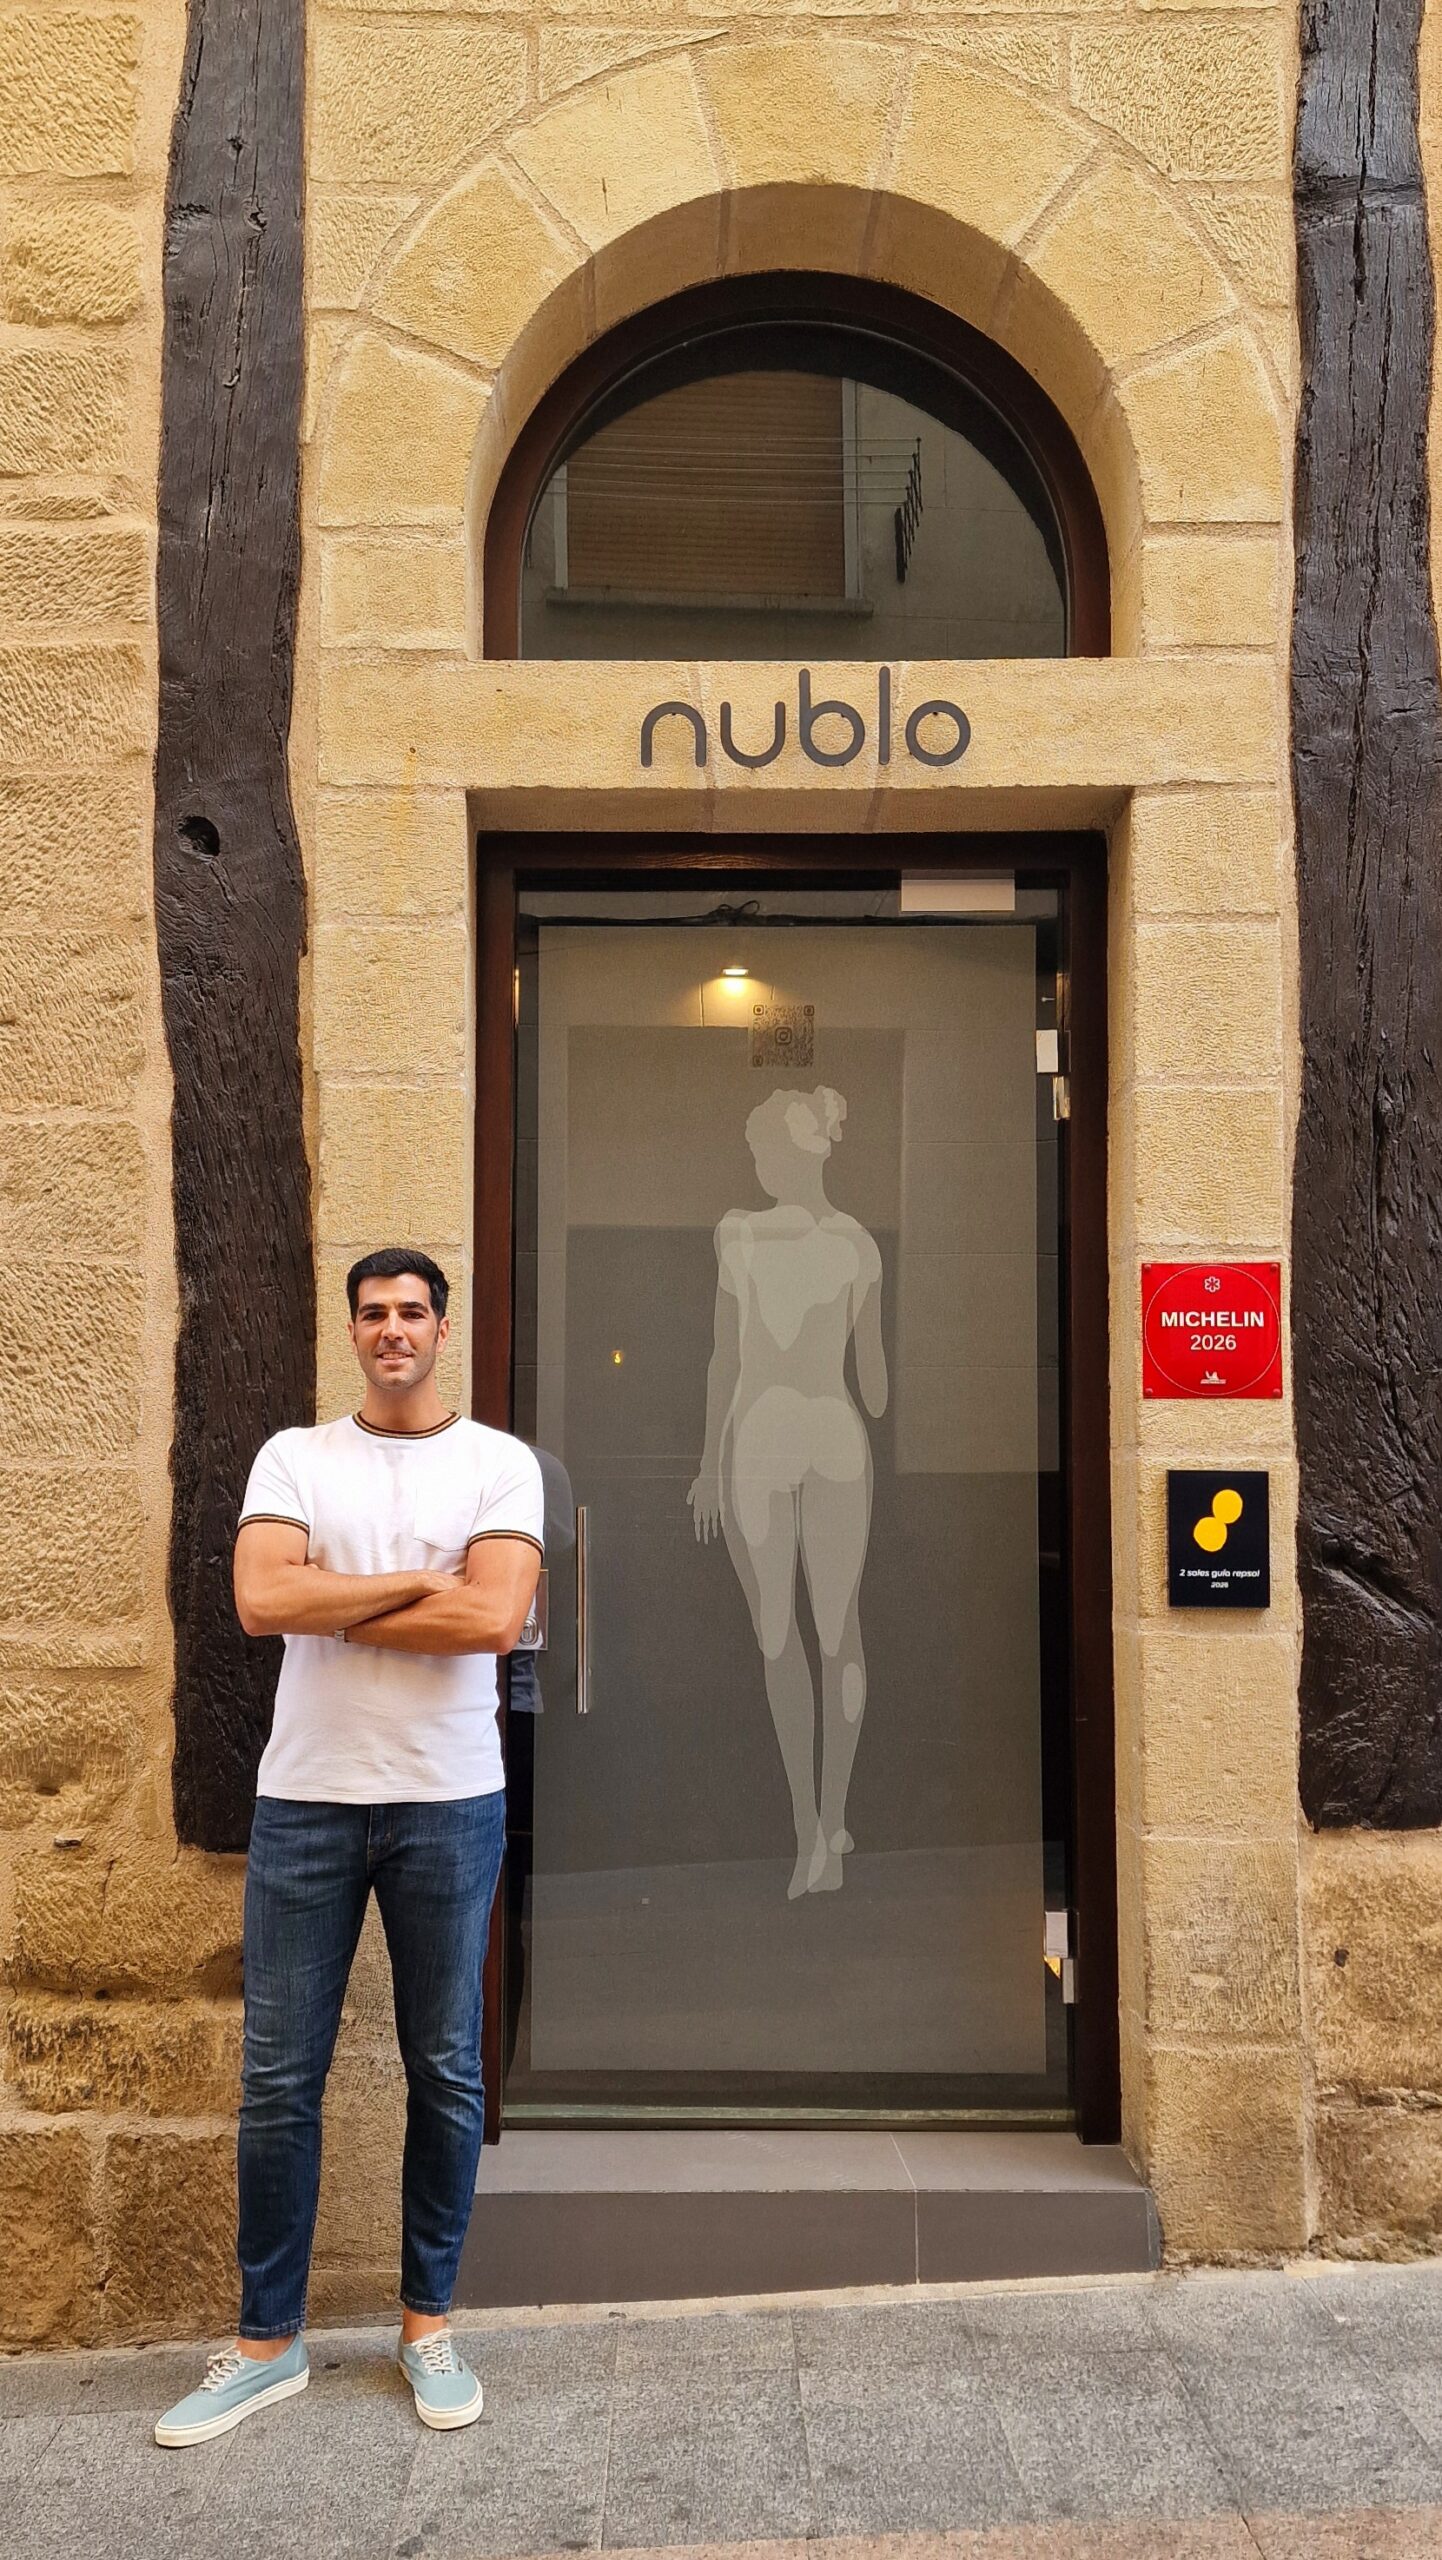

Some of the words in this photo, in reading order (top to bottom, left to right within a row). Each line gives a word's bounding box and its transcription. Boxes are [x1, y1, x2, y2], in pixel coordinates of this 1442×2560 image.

[641, 666, 972, 768] nublo
[1161, 1311, 1265, 1327] MICHELIN
[1190, 1334, 1237, 1350] 2026
[1179, 1569, 1186, 1577] 2
[1187, 1569, 1210, 1577] soles
[1232, 1569, 1260, 1579] repsol
